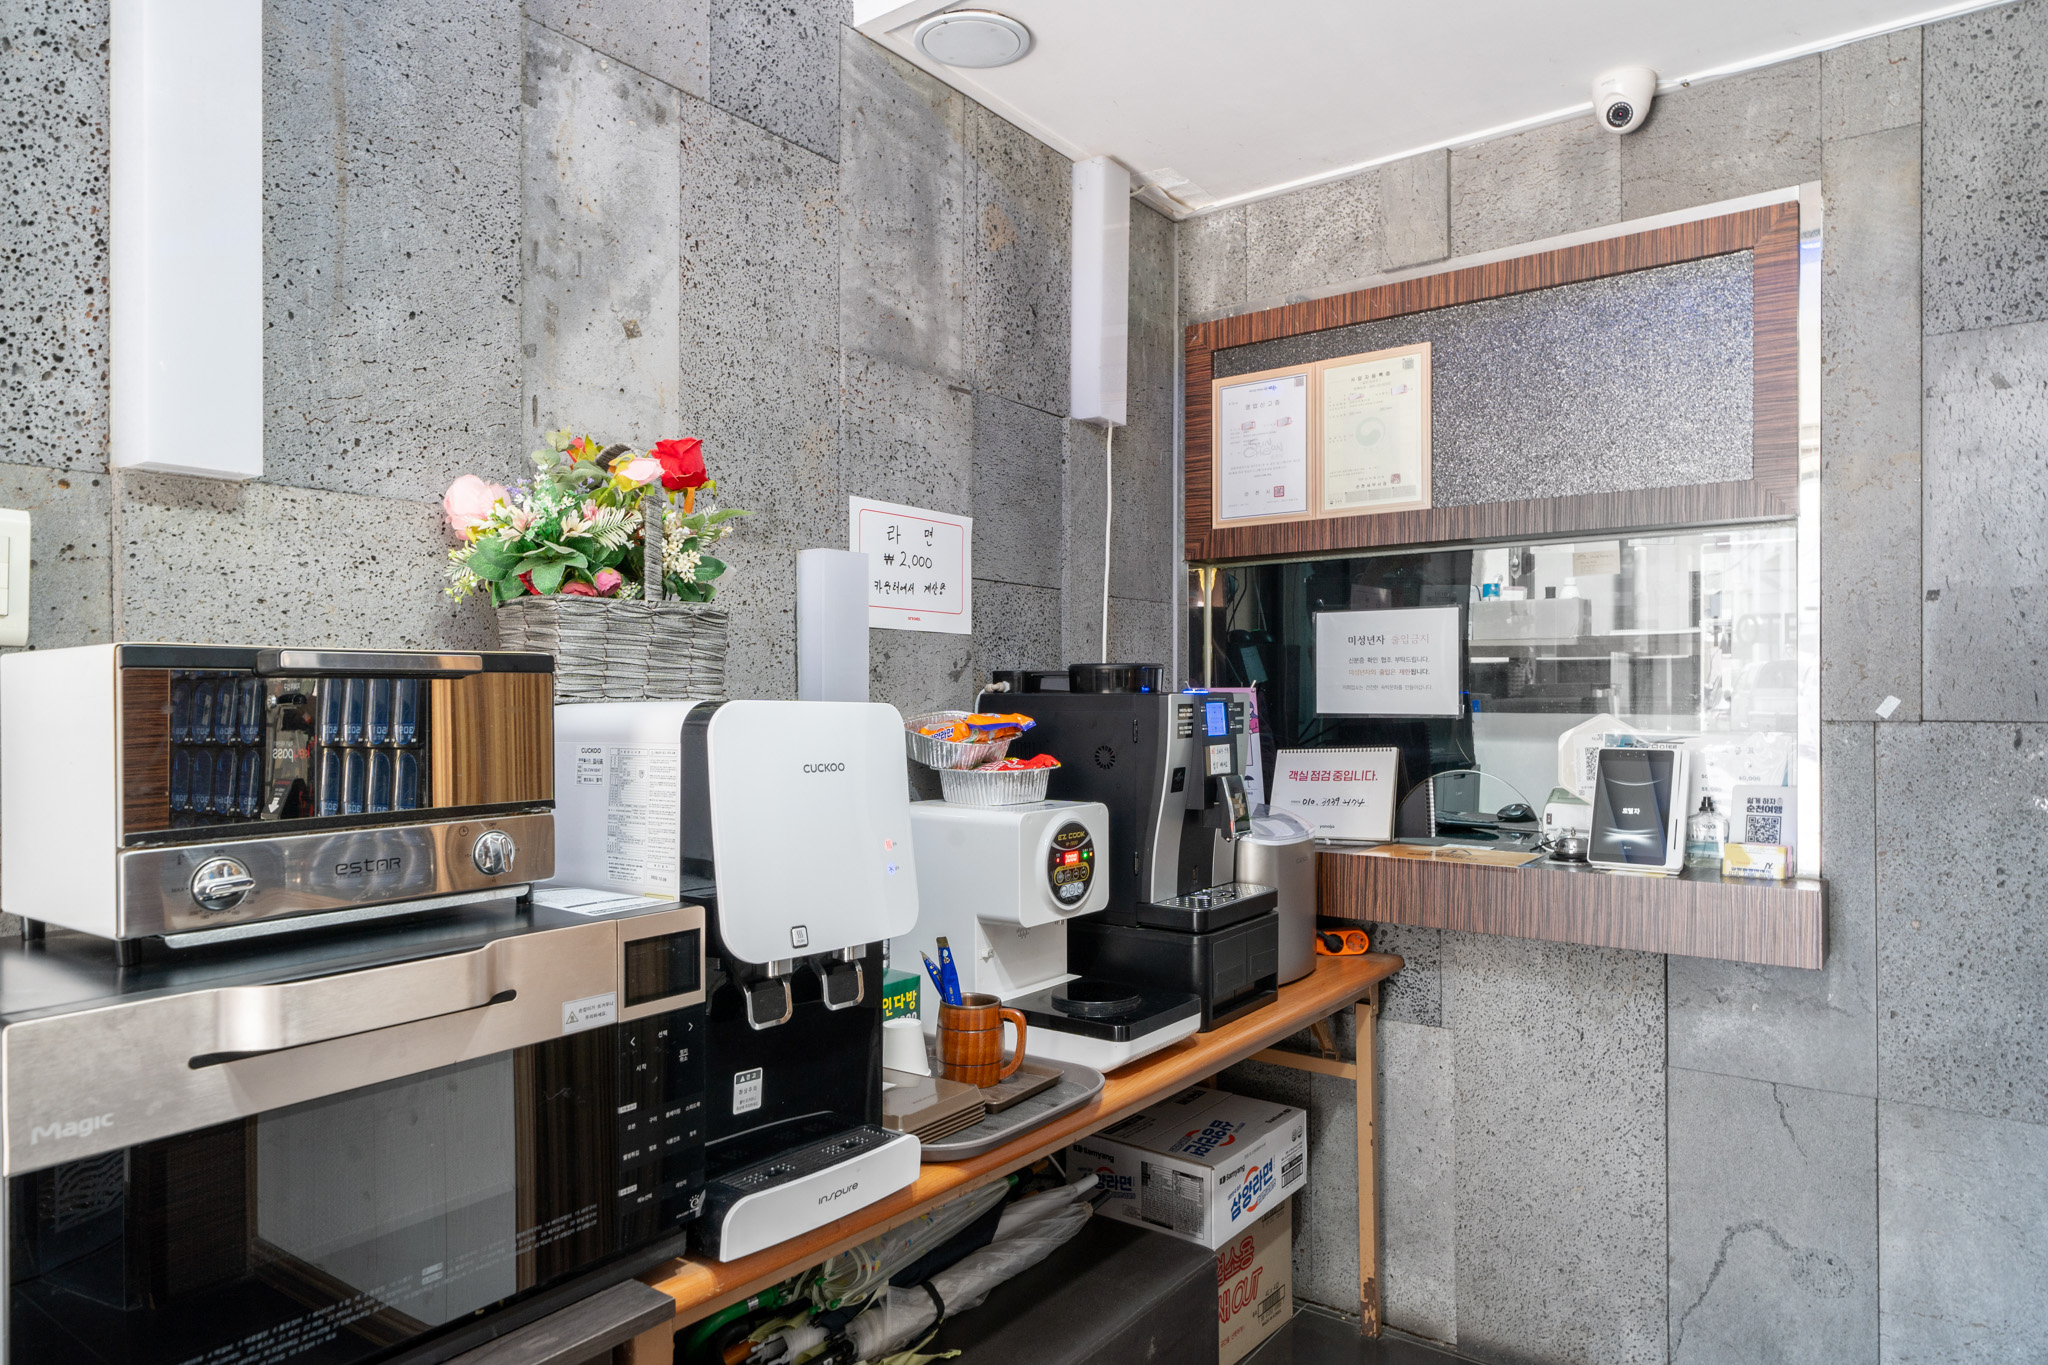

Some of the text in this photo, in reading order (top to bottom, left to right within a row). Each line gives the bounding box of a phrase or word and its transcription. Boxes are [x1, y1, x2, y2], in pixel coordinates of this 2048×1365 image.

[1348, 633, 1429, 646] 미성년자 출입금지
[1348, 656, 1364, 664] 신분증
[1367, 656, 1378, 664] 확인
[1381, 656, 1392, 664] 협조
[1348, 668, 1376, 676] 미성년자의
[1379, 668, 1396, 676] 출입은
[803, 762, 846, 774] CUCKOO
[1288, 770, 1378, 781] 객실 점검 중입니다.
[1747, 797, 1777, 805] 쉽게 하자
[1746, 804, 1783, 814] 순천여행
[1058, 831, 1086, 841] EZ COOK
[578, 1005, 596, 1014] 손잡이가
[658, 1029, 668, 1039] 선택
[636, 1063, 647, 1072] 시작
[30, 1112, 115, 1146] Magic
[1083, 1147, 1115, 1164] Samyang
[1226, 1164, 1246, 1181] Samyang
[818, 1181, 859, 1205] inspure
[1231, 1157, 1273, 1222] 삼양라면
[1232, 1266, 1263, 1315] OUT
